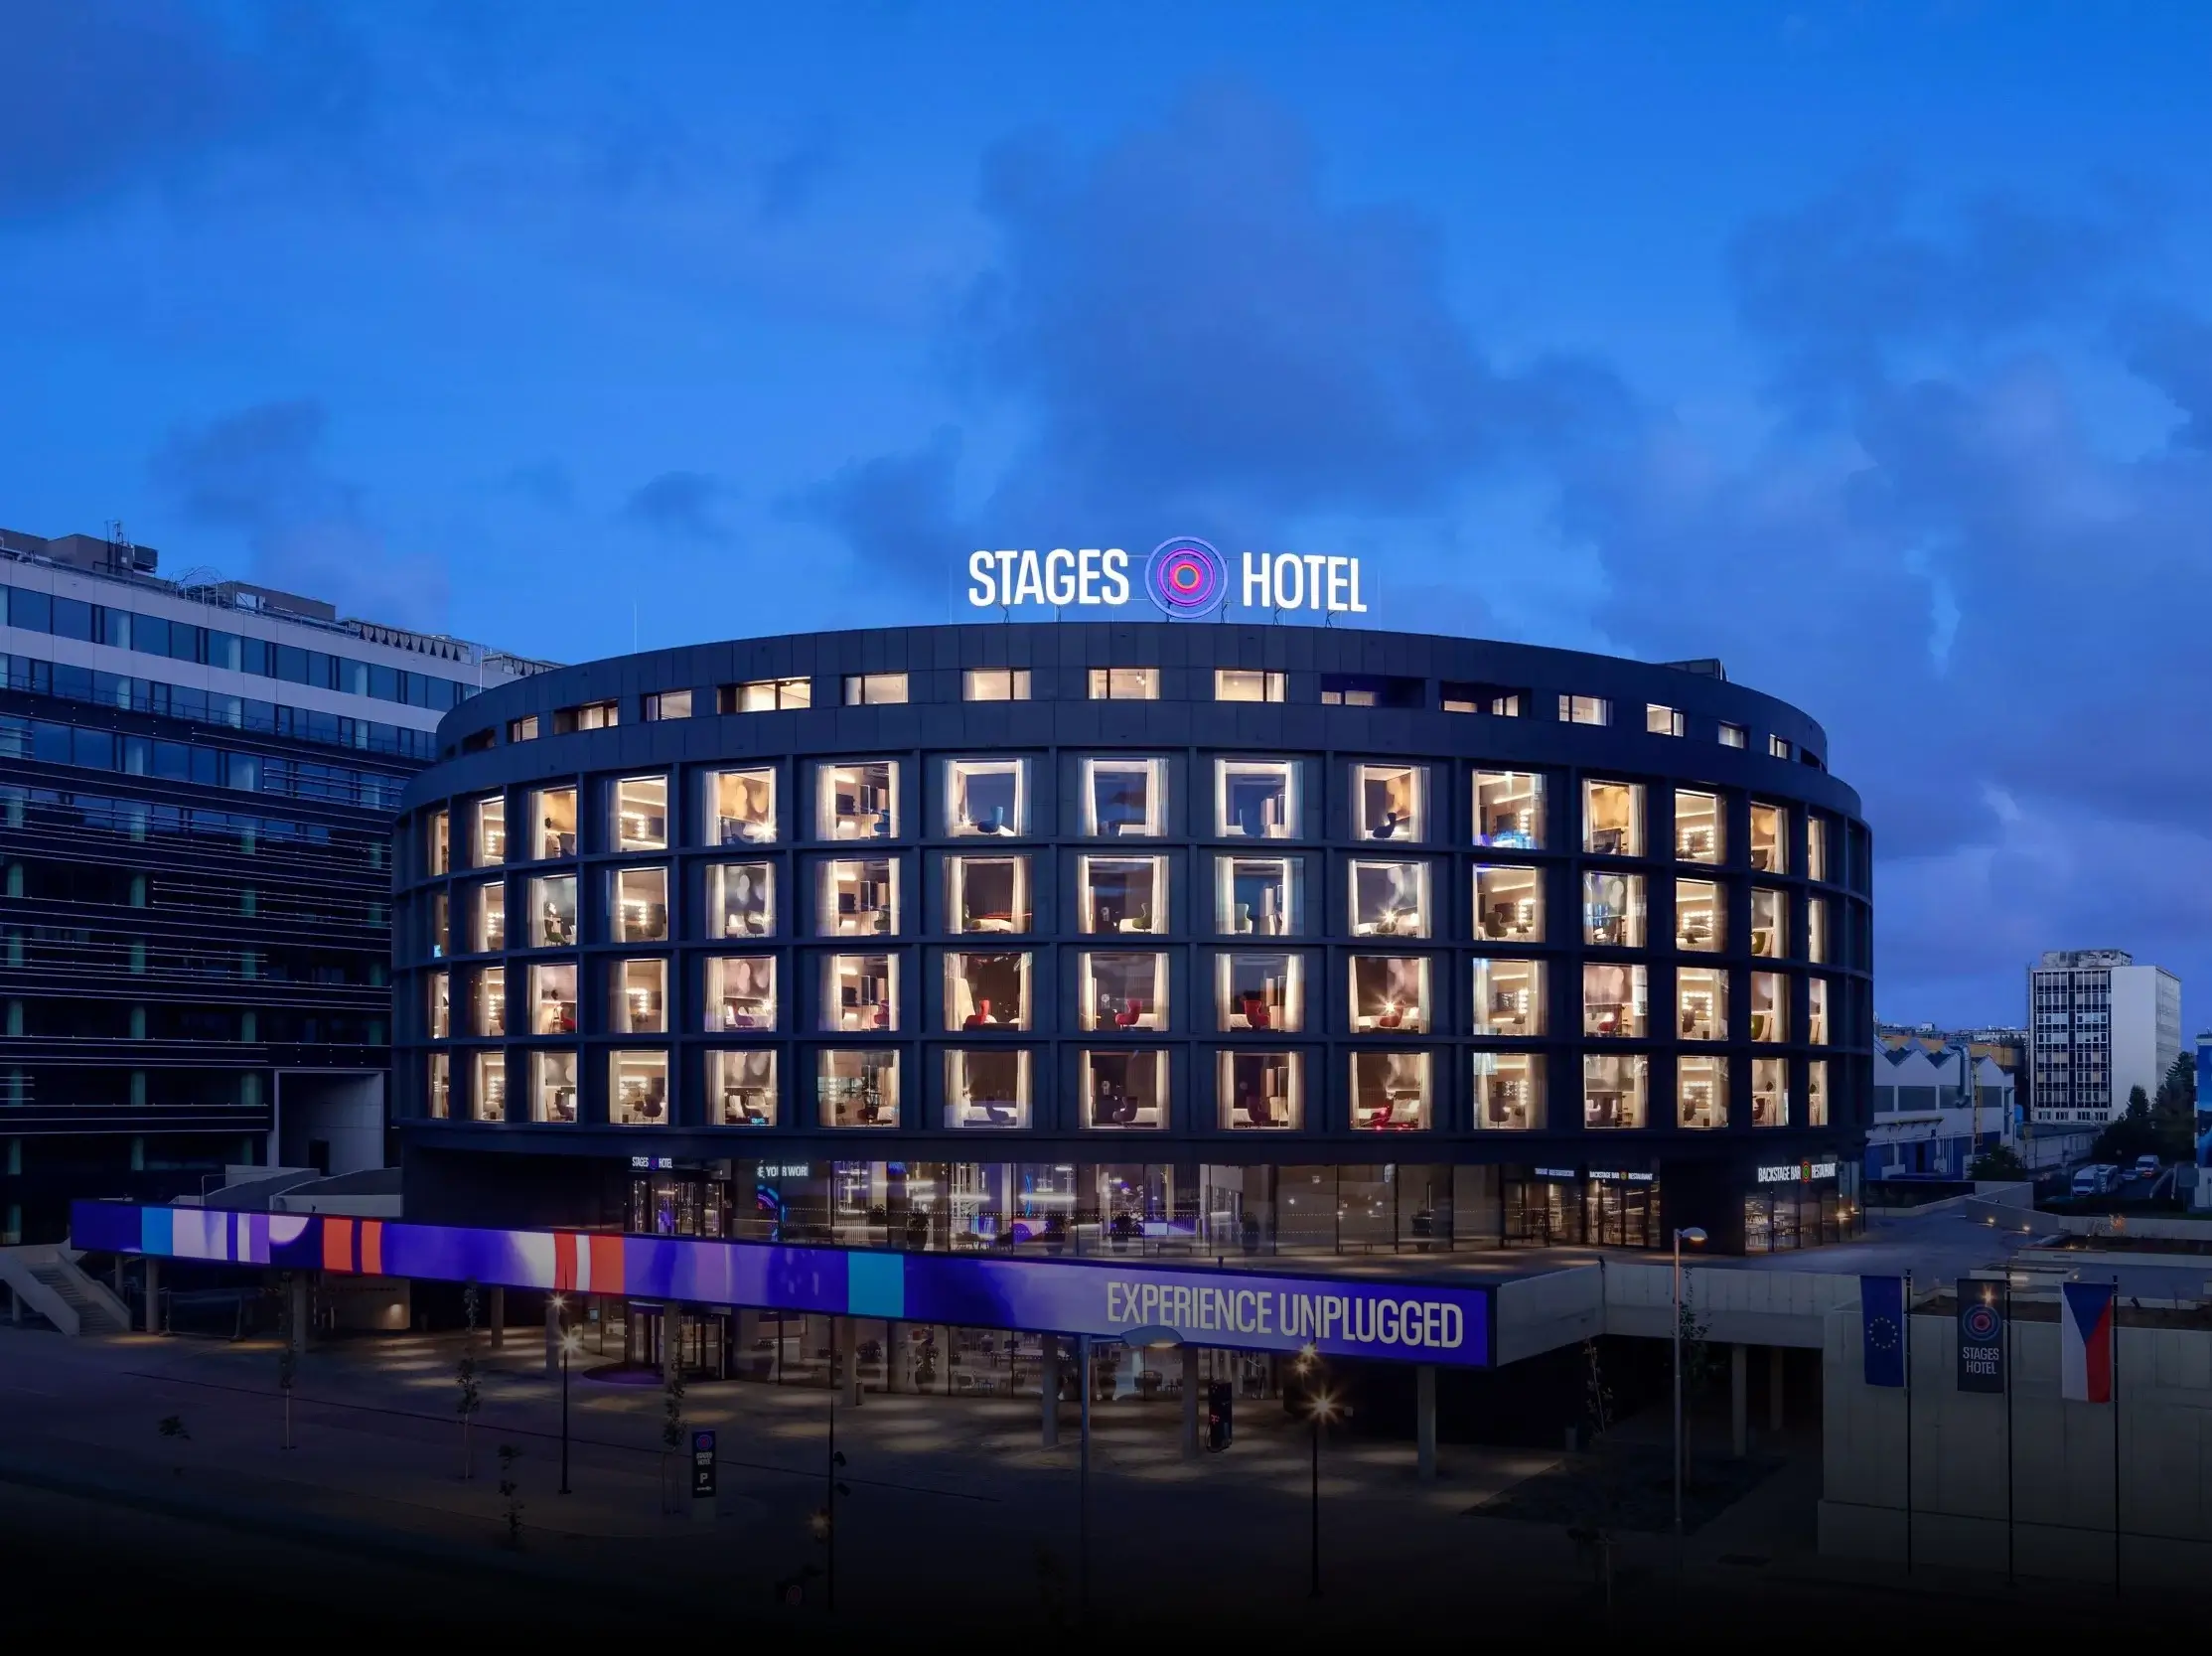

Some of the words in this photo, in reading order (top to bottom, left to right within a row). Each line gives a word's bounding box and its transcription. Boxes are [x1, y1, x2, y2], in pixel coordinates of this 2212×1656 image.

[968, 549, 1129, 607] STAGES
[1243, 552, 1368, 612] HOTEL
[632, 1156, 649, 1167] STAGES
[659, 1157, 672, 1168] HOTEL
[1758, 1165, 1790, 1182] BACKSTAGE
[1791, 1165, 1802, 1180] BAR
[1811, 1163, 1836, 1178] RESTAURANT
[1106, 1281, 1272, 1334] EXPERIENCE
[1279, 1293, 1463, 1348] UNPLUGGED
[1962, 1346, 1999, 1361] STAGES
[1966, 1360, 1996, 1375] HOTEL
[699, 1472, 708, 1484] P
